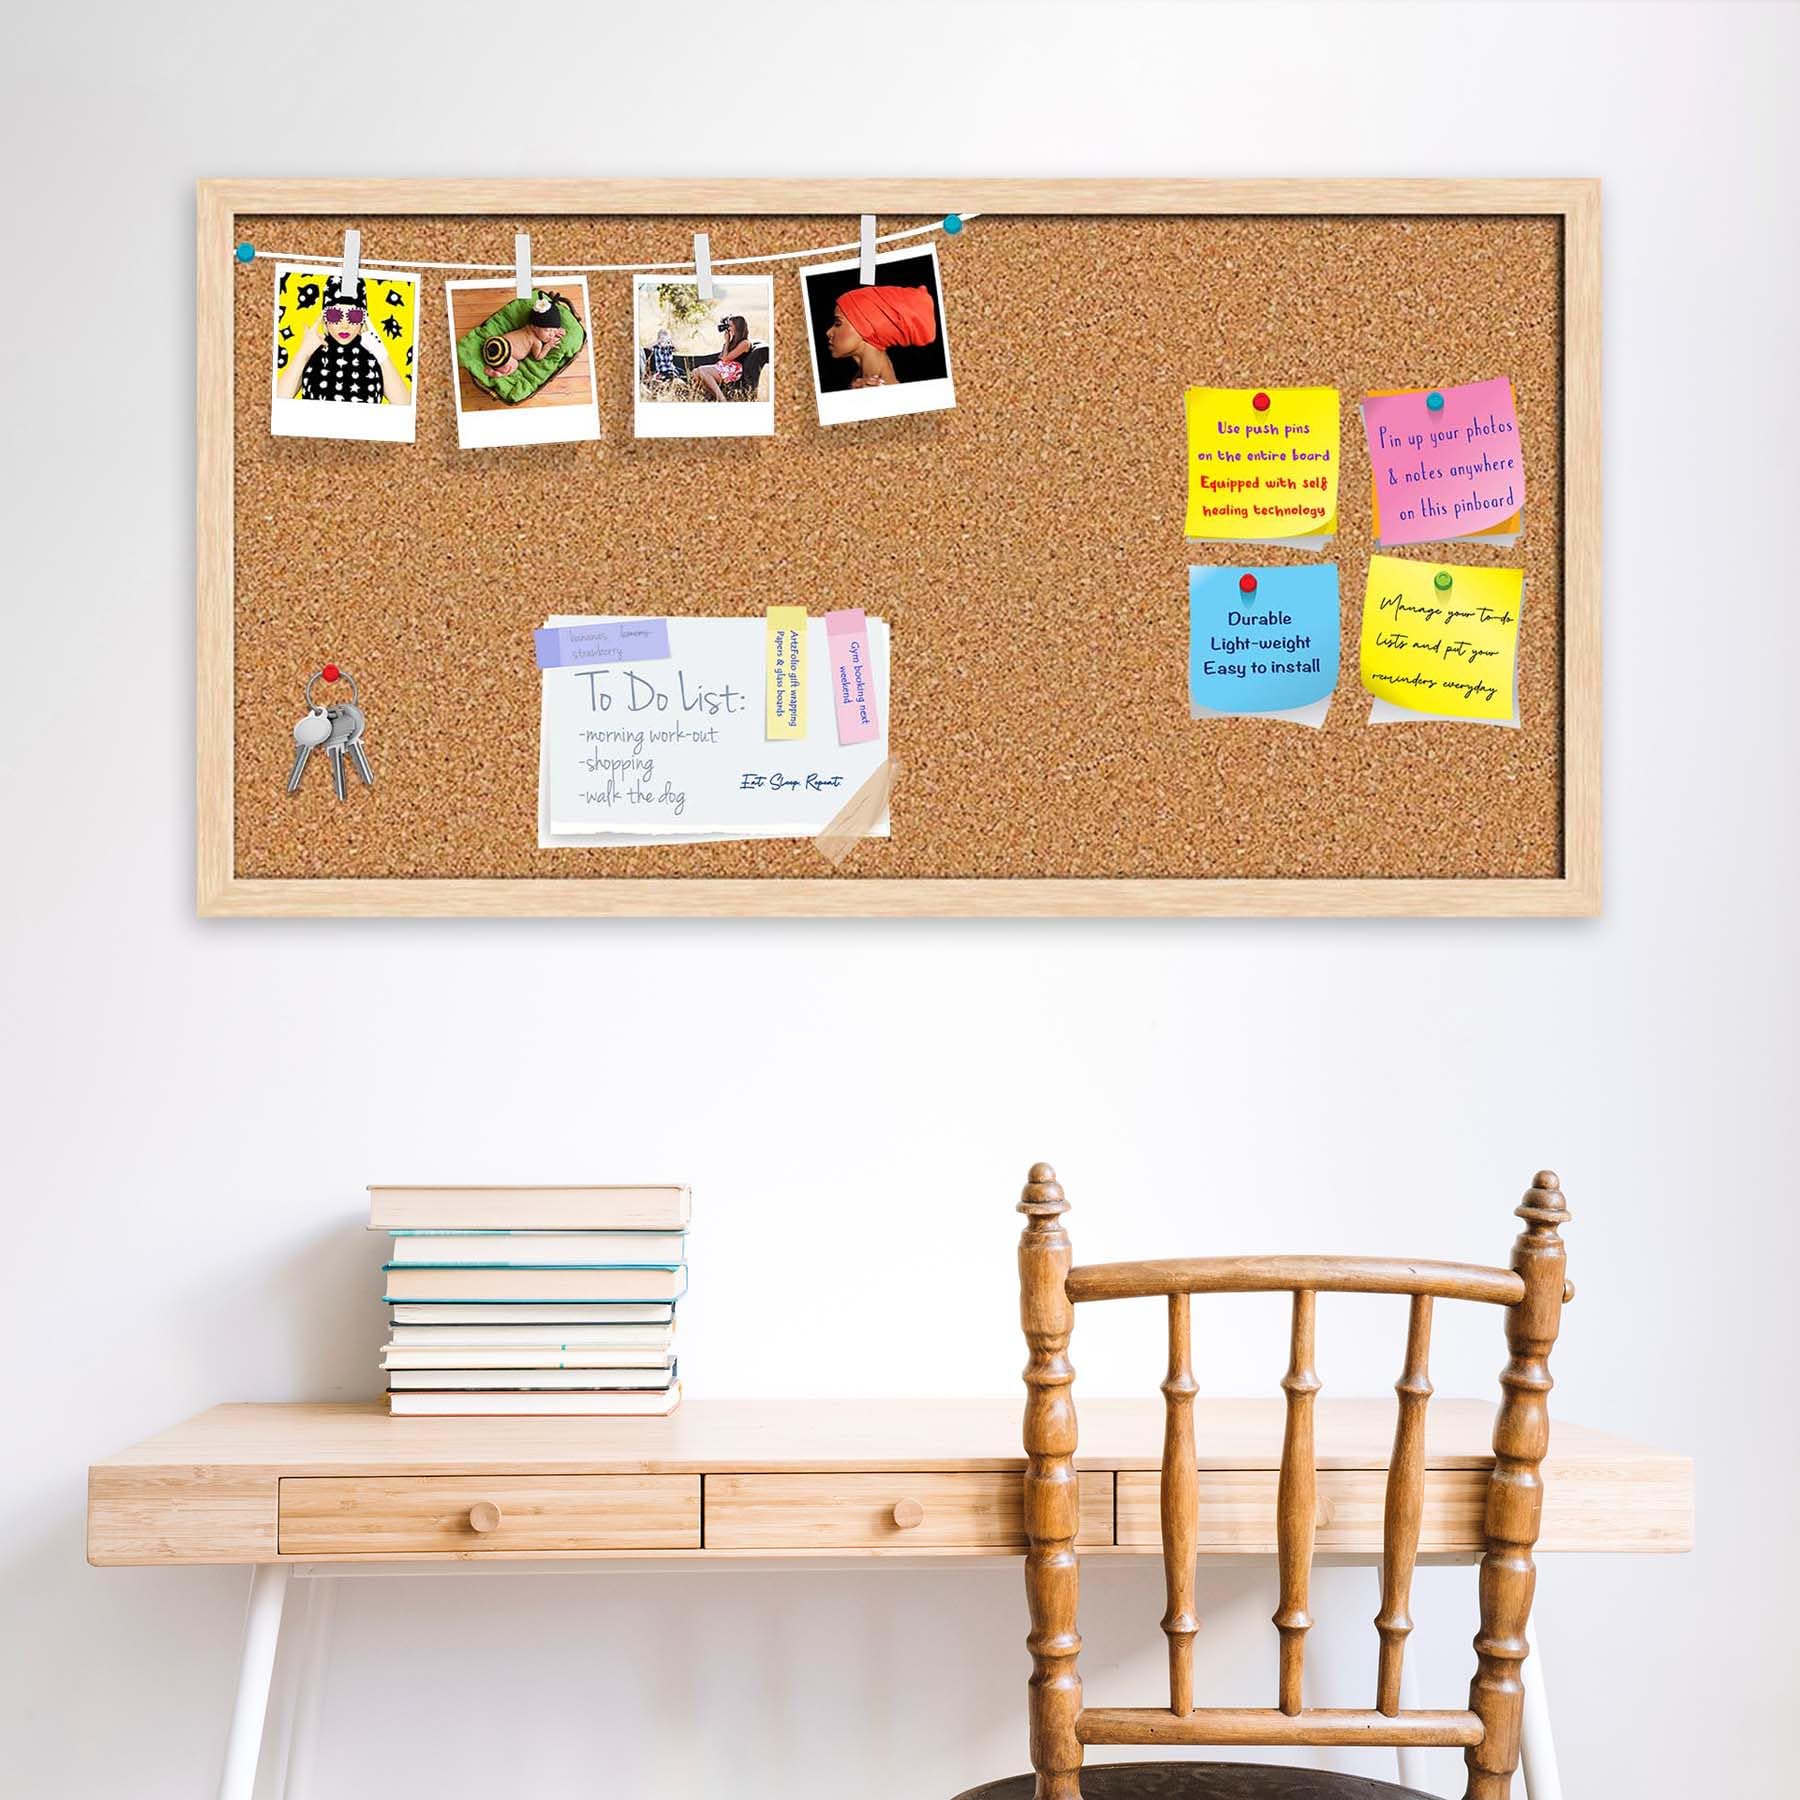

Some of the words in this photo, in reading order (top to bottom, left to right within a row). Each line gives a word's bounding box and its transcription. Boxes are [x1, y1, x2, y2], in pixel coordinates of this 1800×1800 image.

[1217, 421, 1240, 434] Use
[1245, 423, 1279, 439] push
[1285, 423, 1310, 439] pins
[1379, 425, 1401, 449] Pin
[1408, 434, 1423, 450] up
[1430, 429, 1459, 448] your
[1466, 414, 1513, 443] photos
[1198, 452, 1212, 461] on
[1217, 450, 1241, 462] the
[1247, 450, 1286, 461] entire
[1292, 449, 1330, 461] board
[1388, 468, 1398, 485] &
[1405, 461, 1443, 483] notes
[1450, 452, 1514, 480] anywhere
[1200, 475, 1260, 493] Equipped
[1265, 477, 1296, 489] with
[1302, 476, 1328, 491] self
[1202, 504, 1248, 518] healing
[1253, 504, 1326, 519] technology
[1400, 510, 1415, 521] on
[1421, 497, 1448, 518] this
[1454, 486, 1514, 519] pinboard
[1228, 610, 1292, 626] Durable
[1379, 593, 1443, 621] Manage
[1445, 609, 1475, 624] your
[774, 630, 785, 657] Papers
[850, 641, 860, 663] Gym
[1210, 635, 1311, 654] Light-weight
[1412, 639, 1442, 653] and
[1443, 641, 1472, 660] put
[1468, 650, 1499, 663] your
[776, 658, 784, 666] &
[1203, 661, 1246, 678] Easy
[1251, 661, 1267, 674] to
[1271, 658, 1320, 673] install
[774, 668, 786, 688] glass
[788, 672, 800, 687] gift
[839, 665, 853, 704] weekend
[854, 664, 865, 703] booking
[1372, 673, 1437, 688] reminders
[1442, 680, 1498, 701] everyday
[574, 670, 612, 712] To
[623, 670, 669, 712] Do
[678, 670, 746, 715] List:
[776, 689, 786, 717] boards
[788, 690, 797, 726] wrapping
[860, 704, 870, 725] next
[650, 720, 719, 744] work-out
[626, 778, 655, 804] the
[658, 780, 686, 816] dog
